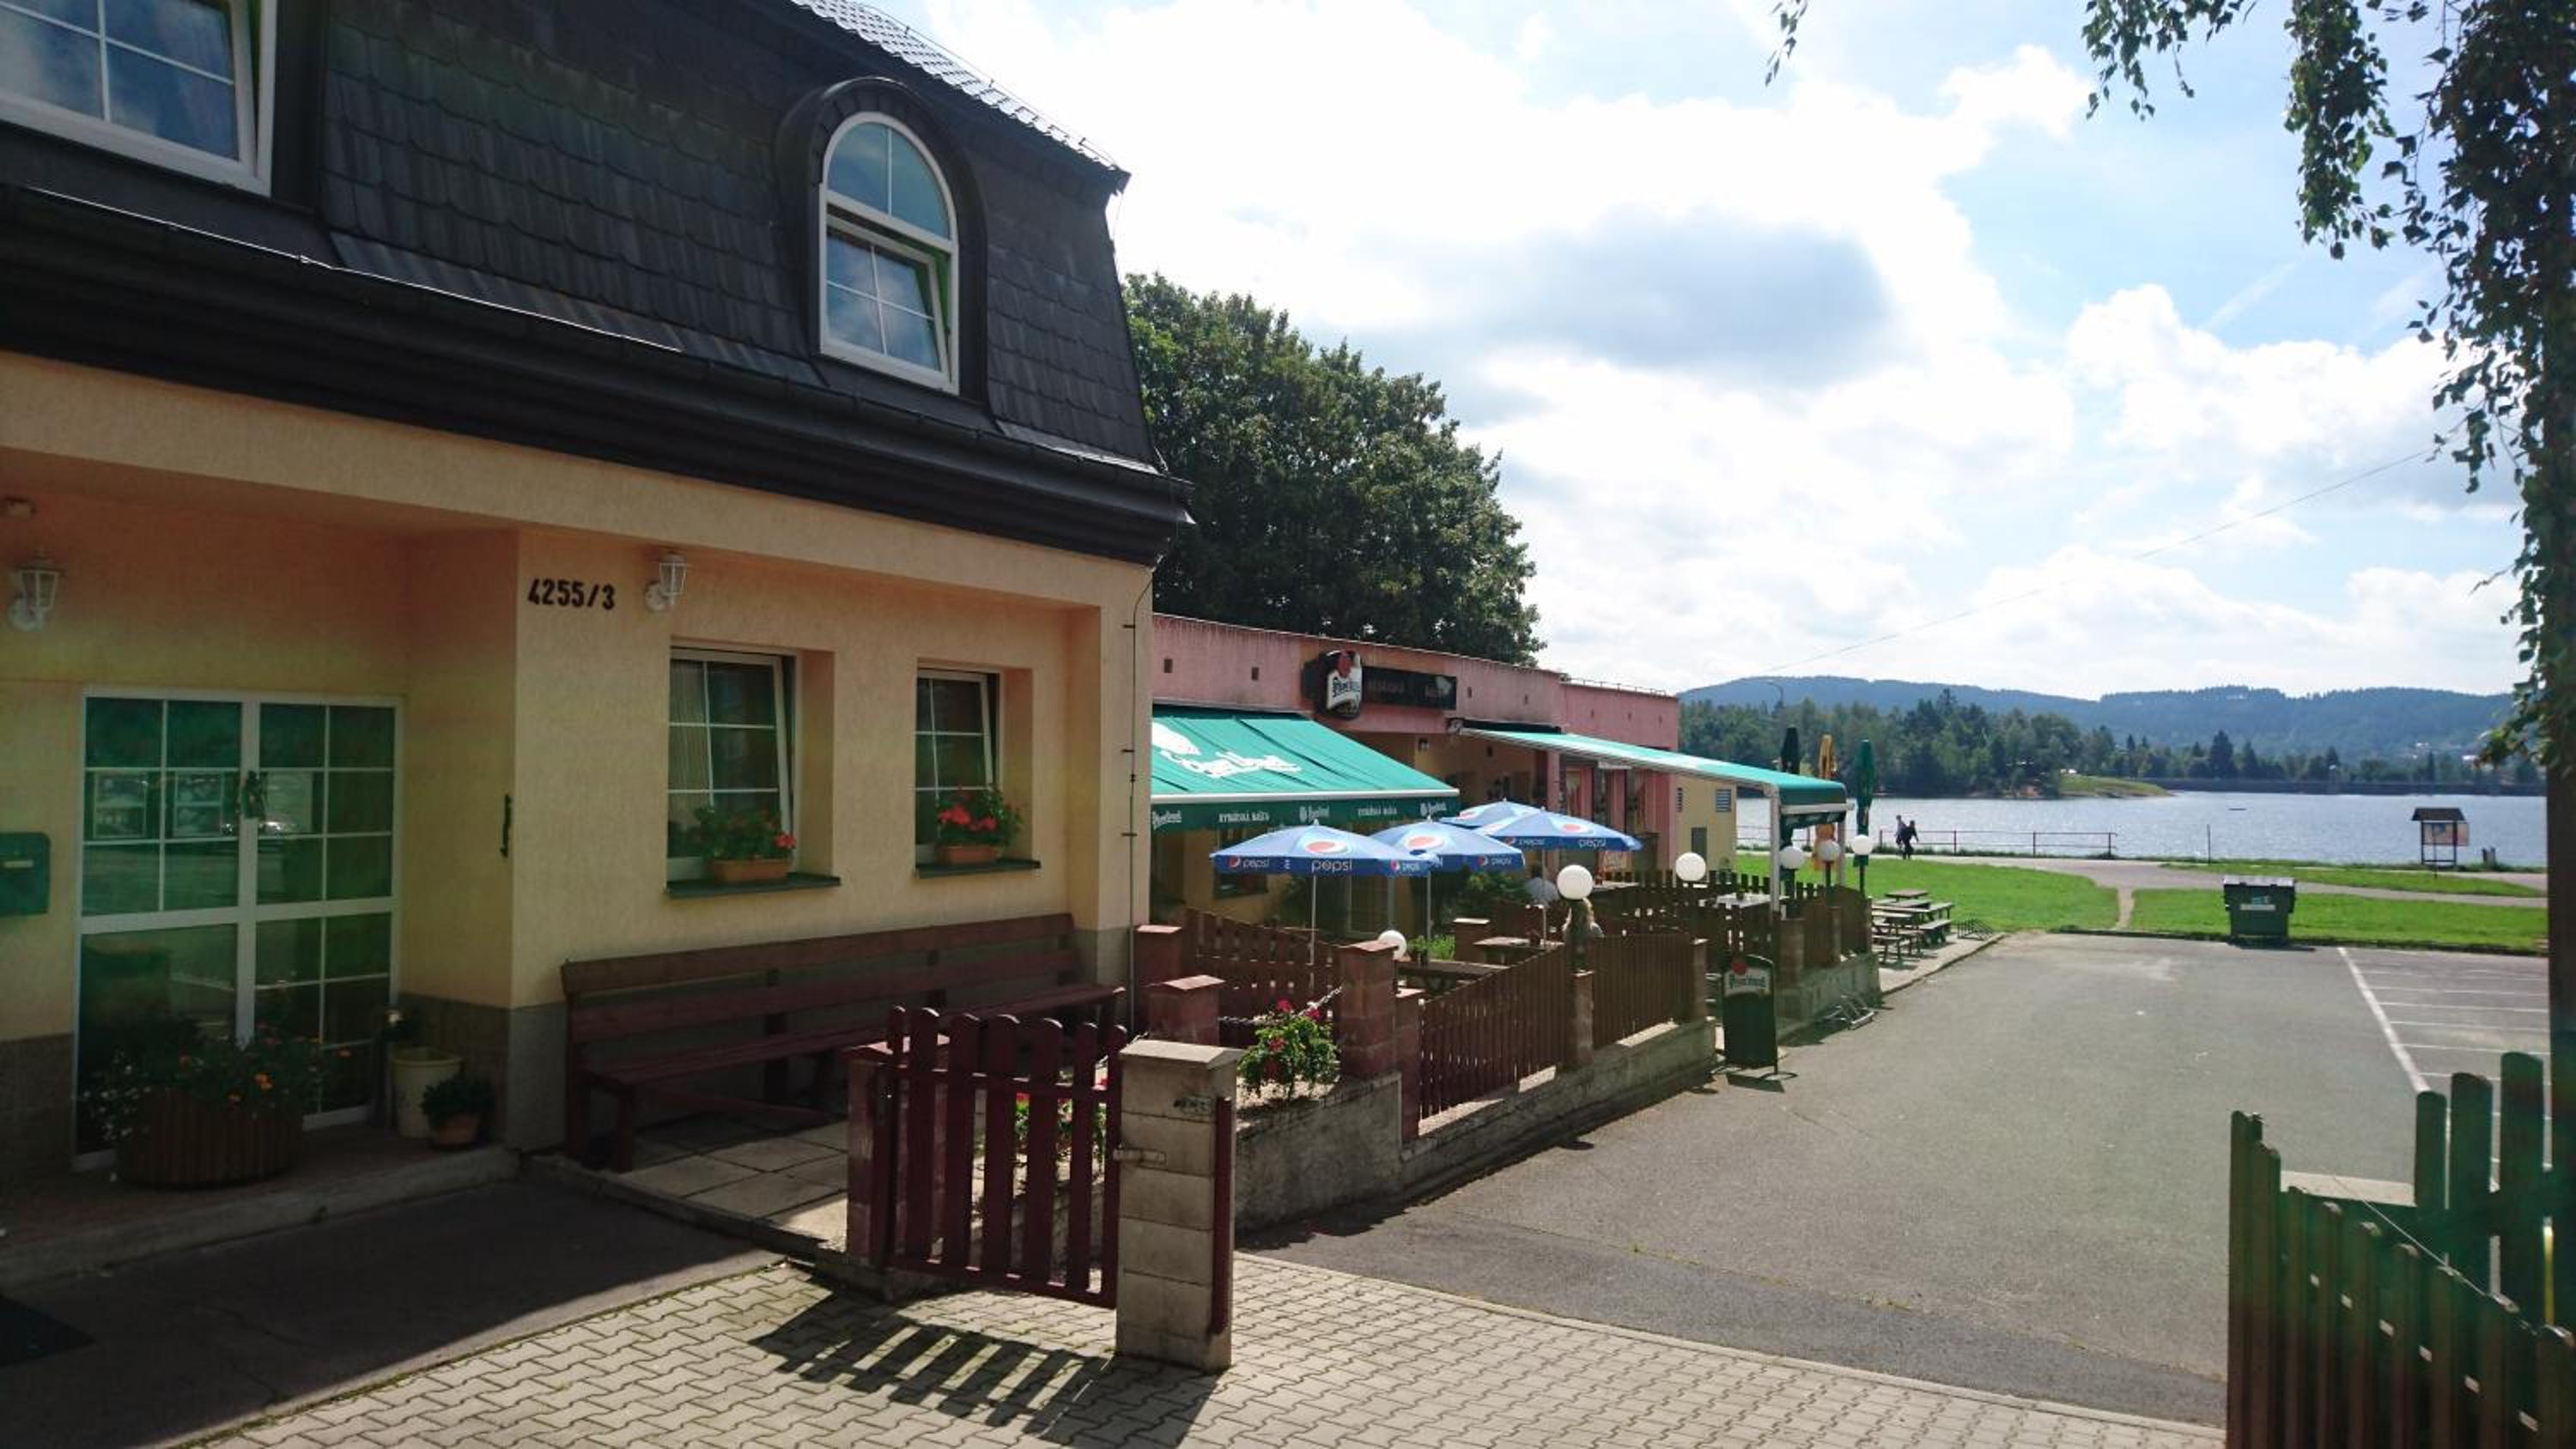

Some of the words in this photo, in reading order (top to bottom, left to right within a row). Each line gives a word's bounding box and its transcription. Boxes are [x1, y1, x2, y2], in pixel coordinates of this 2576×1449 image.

[527, 578, 615, 610] 4255/3
[1242, 858, 1270, 870] pepsi
[1311, 858, 1352, 873] pepsi
